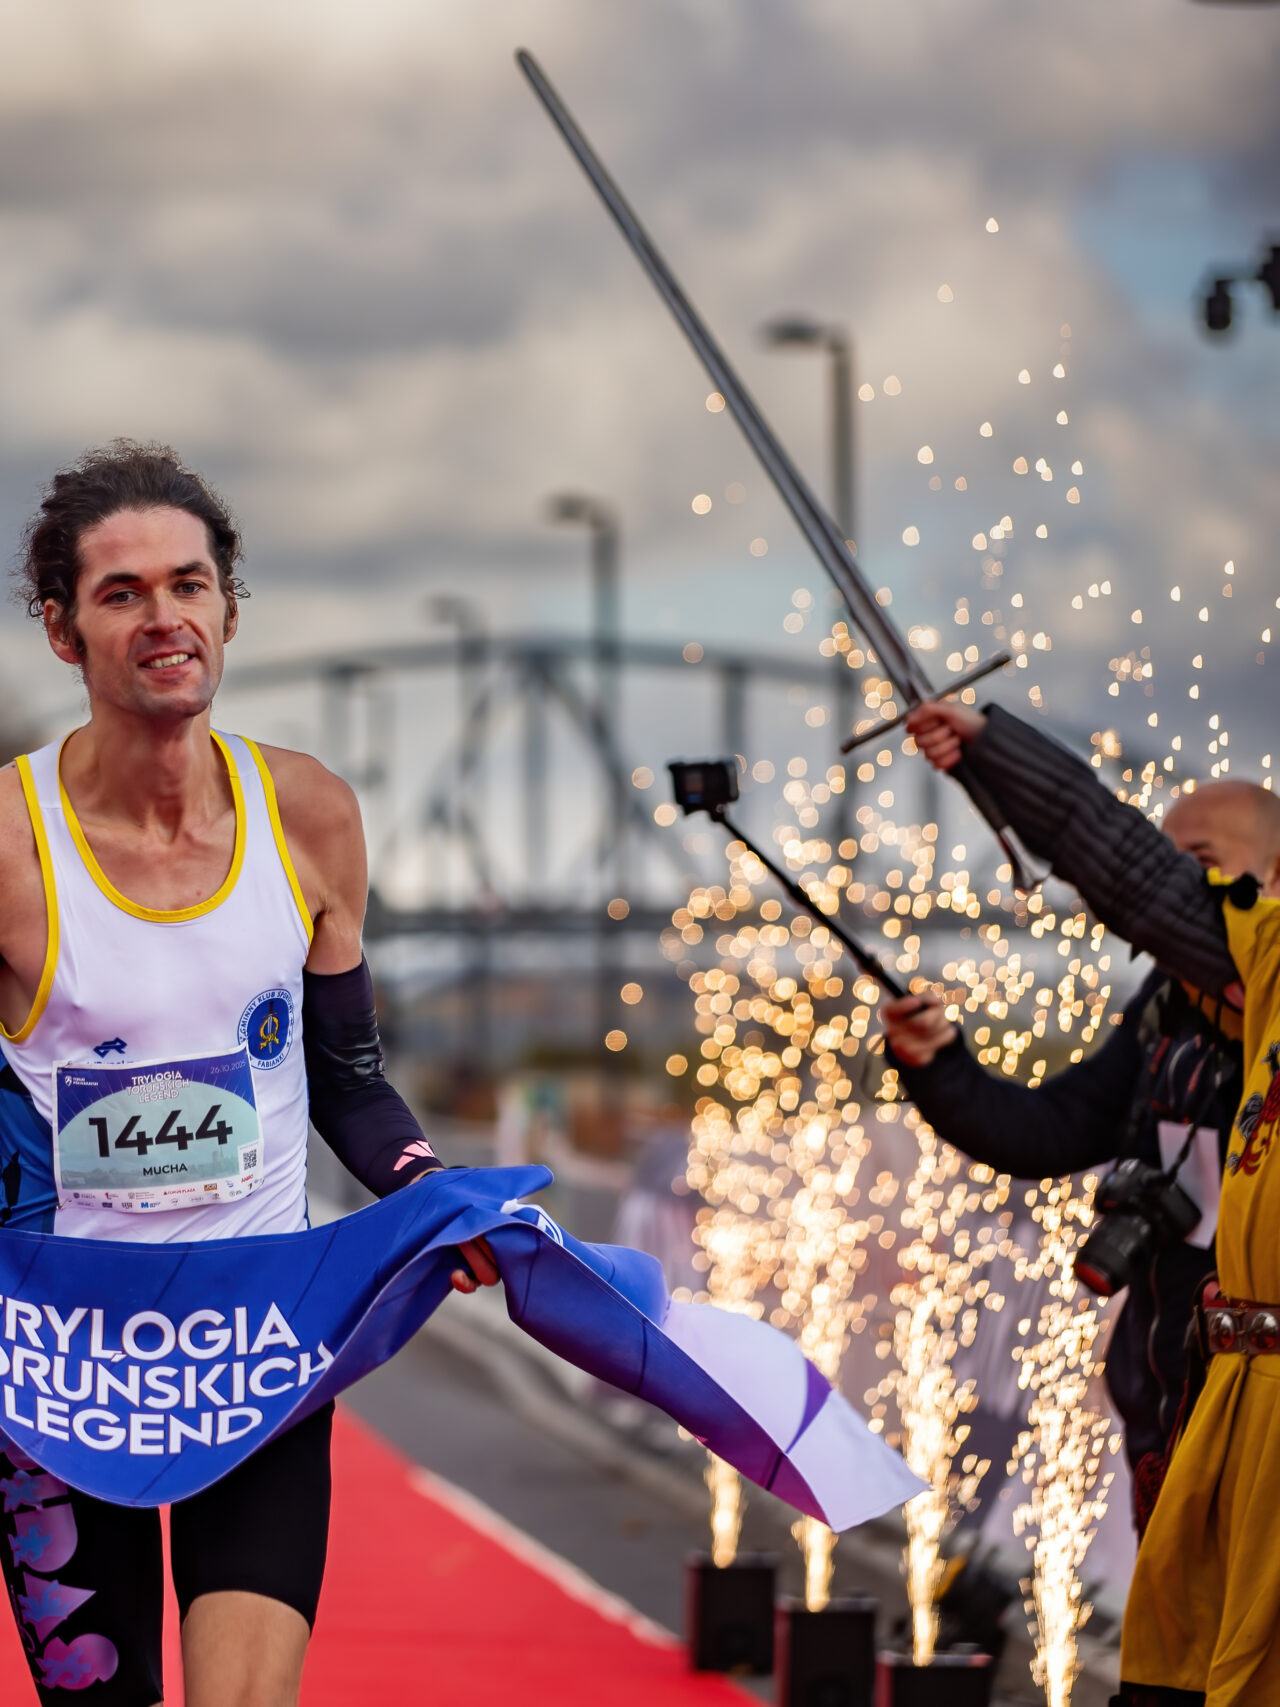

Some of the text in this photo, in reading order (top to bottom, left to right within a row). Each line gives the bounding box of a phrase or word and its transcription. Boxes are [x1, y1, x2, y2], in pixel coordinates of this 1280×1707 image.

[257, 991, 276, 1004] KLUB
[257, 1053, 285, 1068] FABIANKI
[131, 1070, 183, 1086] TRYLOGIA
[138, 1089, 180, 1104] LEGEND
[88, 1104, 233, 1158] 1444
[143, 1163, 188, 1177] MUCHA
[3, 1385, 263, 1455] LEGEND
